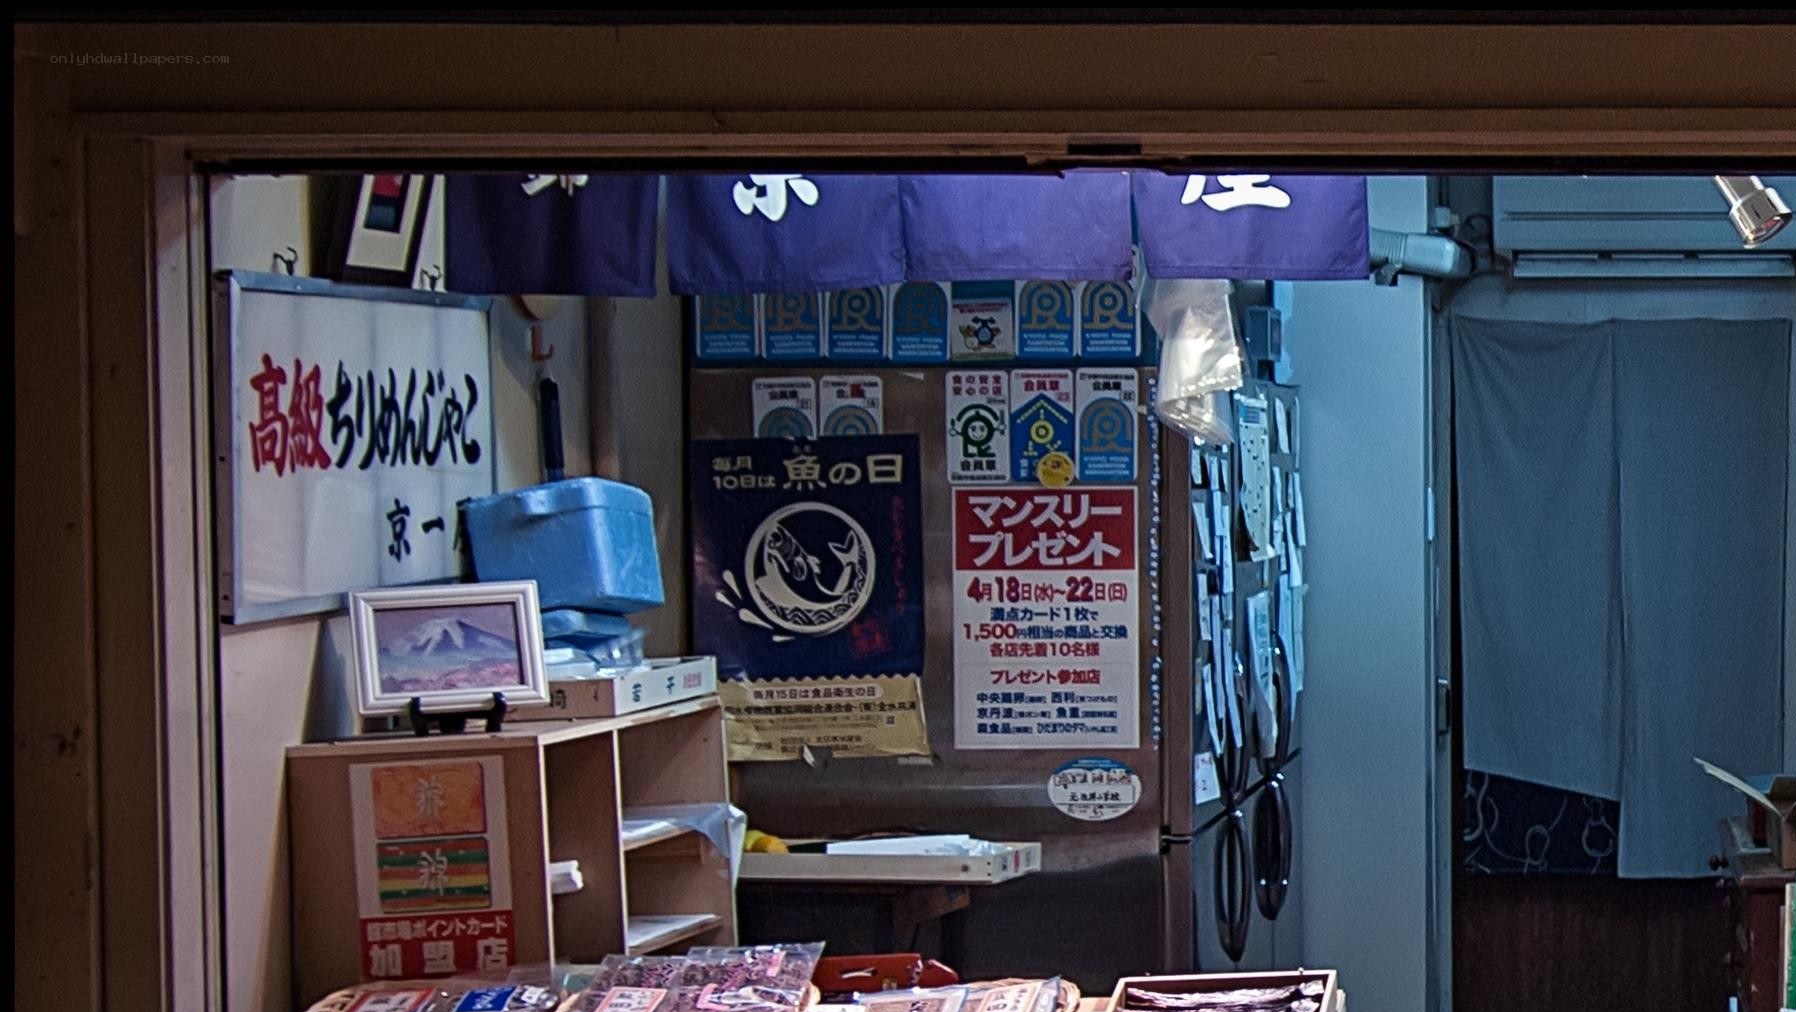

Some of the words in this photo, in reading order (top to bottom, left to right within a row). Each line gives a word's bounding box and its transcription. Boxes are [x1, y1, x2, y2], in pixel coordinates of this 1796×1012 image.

[711, 456, 753, 473] 毎月
[781, 453, 904, 491] 魚の日
[711, 474, 777, 490] 10日は
[968, 494, 1123, 529] マンスリー
[968, 531, 1122, 567] プレゼント
[963, 624, 1128, 642] 1,500円相当の商品と交換
[990, 643, 1100, 658] 各店先着10名様
[990, 669, 1101, 685] プレゼント参加店
[369, 937, 508, 976] 加盟店
